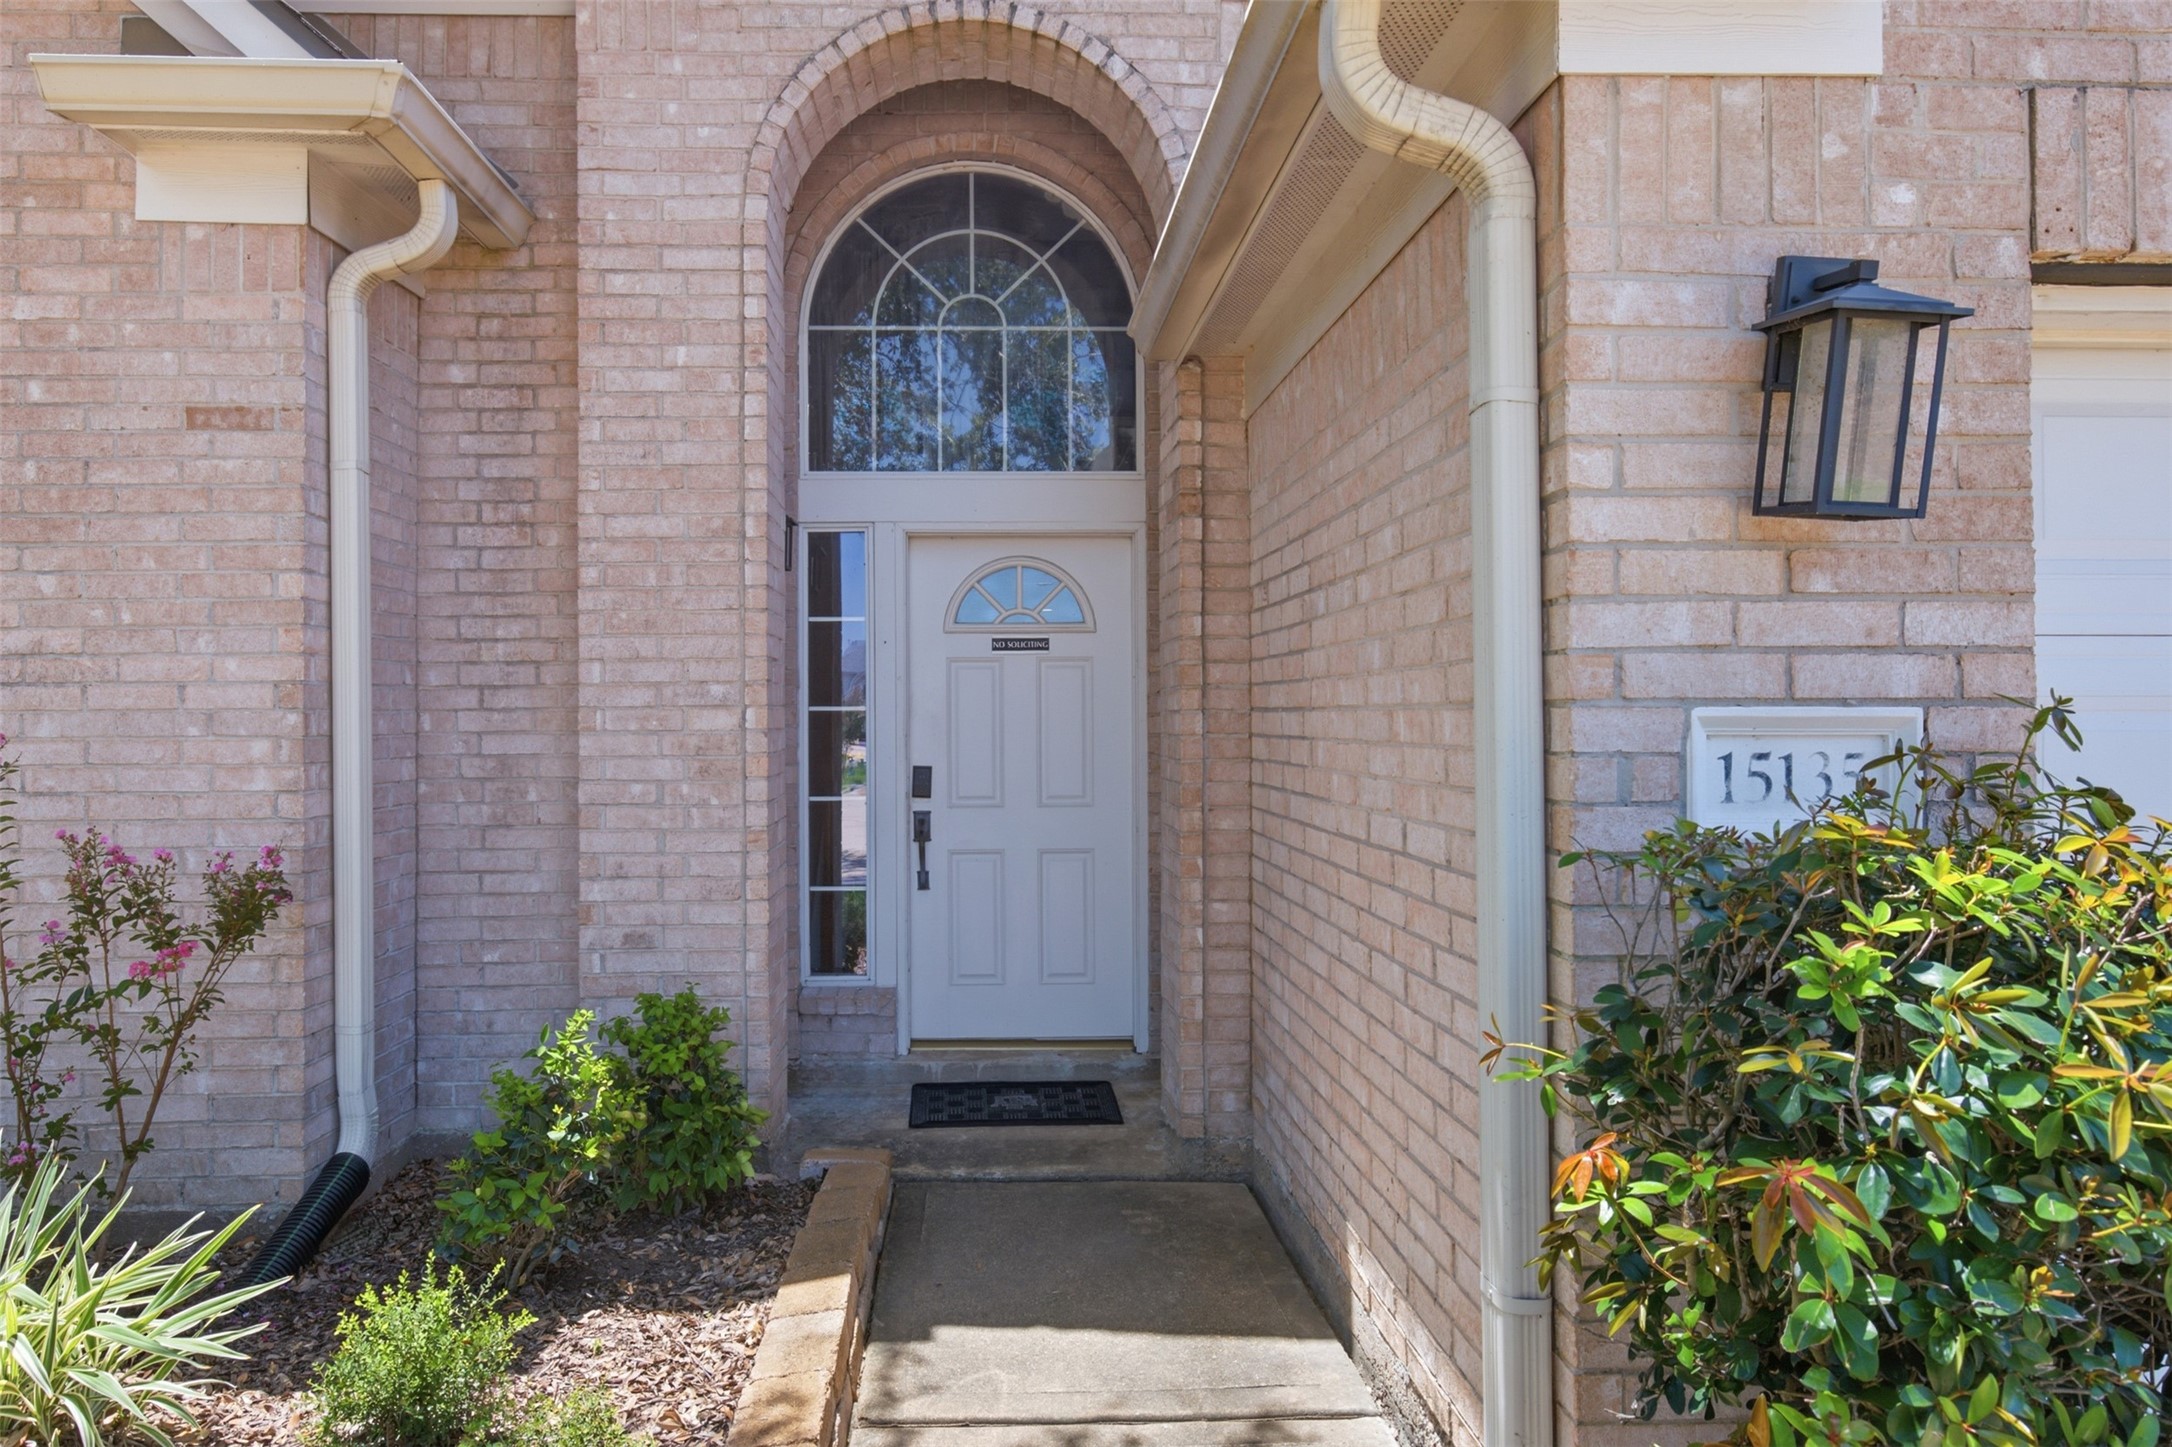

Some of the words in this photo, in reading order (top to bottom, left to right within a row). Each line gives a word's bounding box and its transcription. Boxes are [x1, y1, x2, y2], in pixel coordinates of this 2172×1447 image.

[993, 640, 1005, 648] NO
[1007, 640, 1049, 648] SOLICITING
[1717, 751, 1865, 804] 15135
